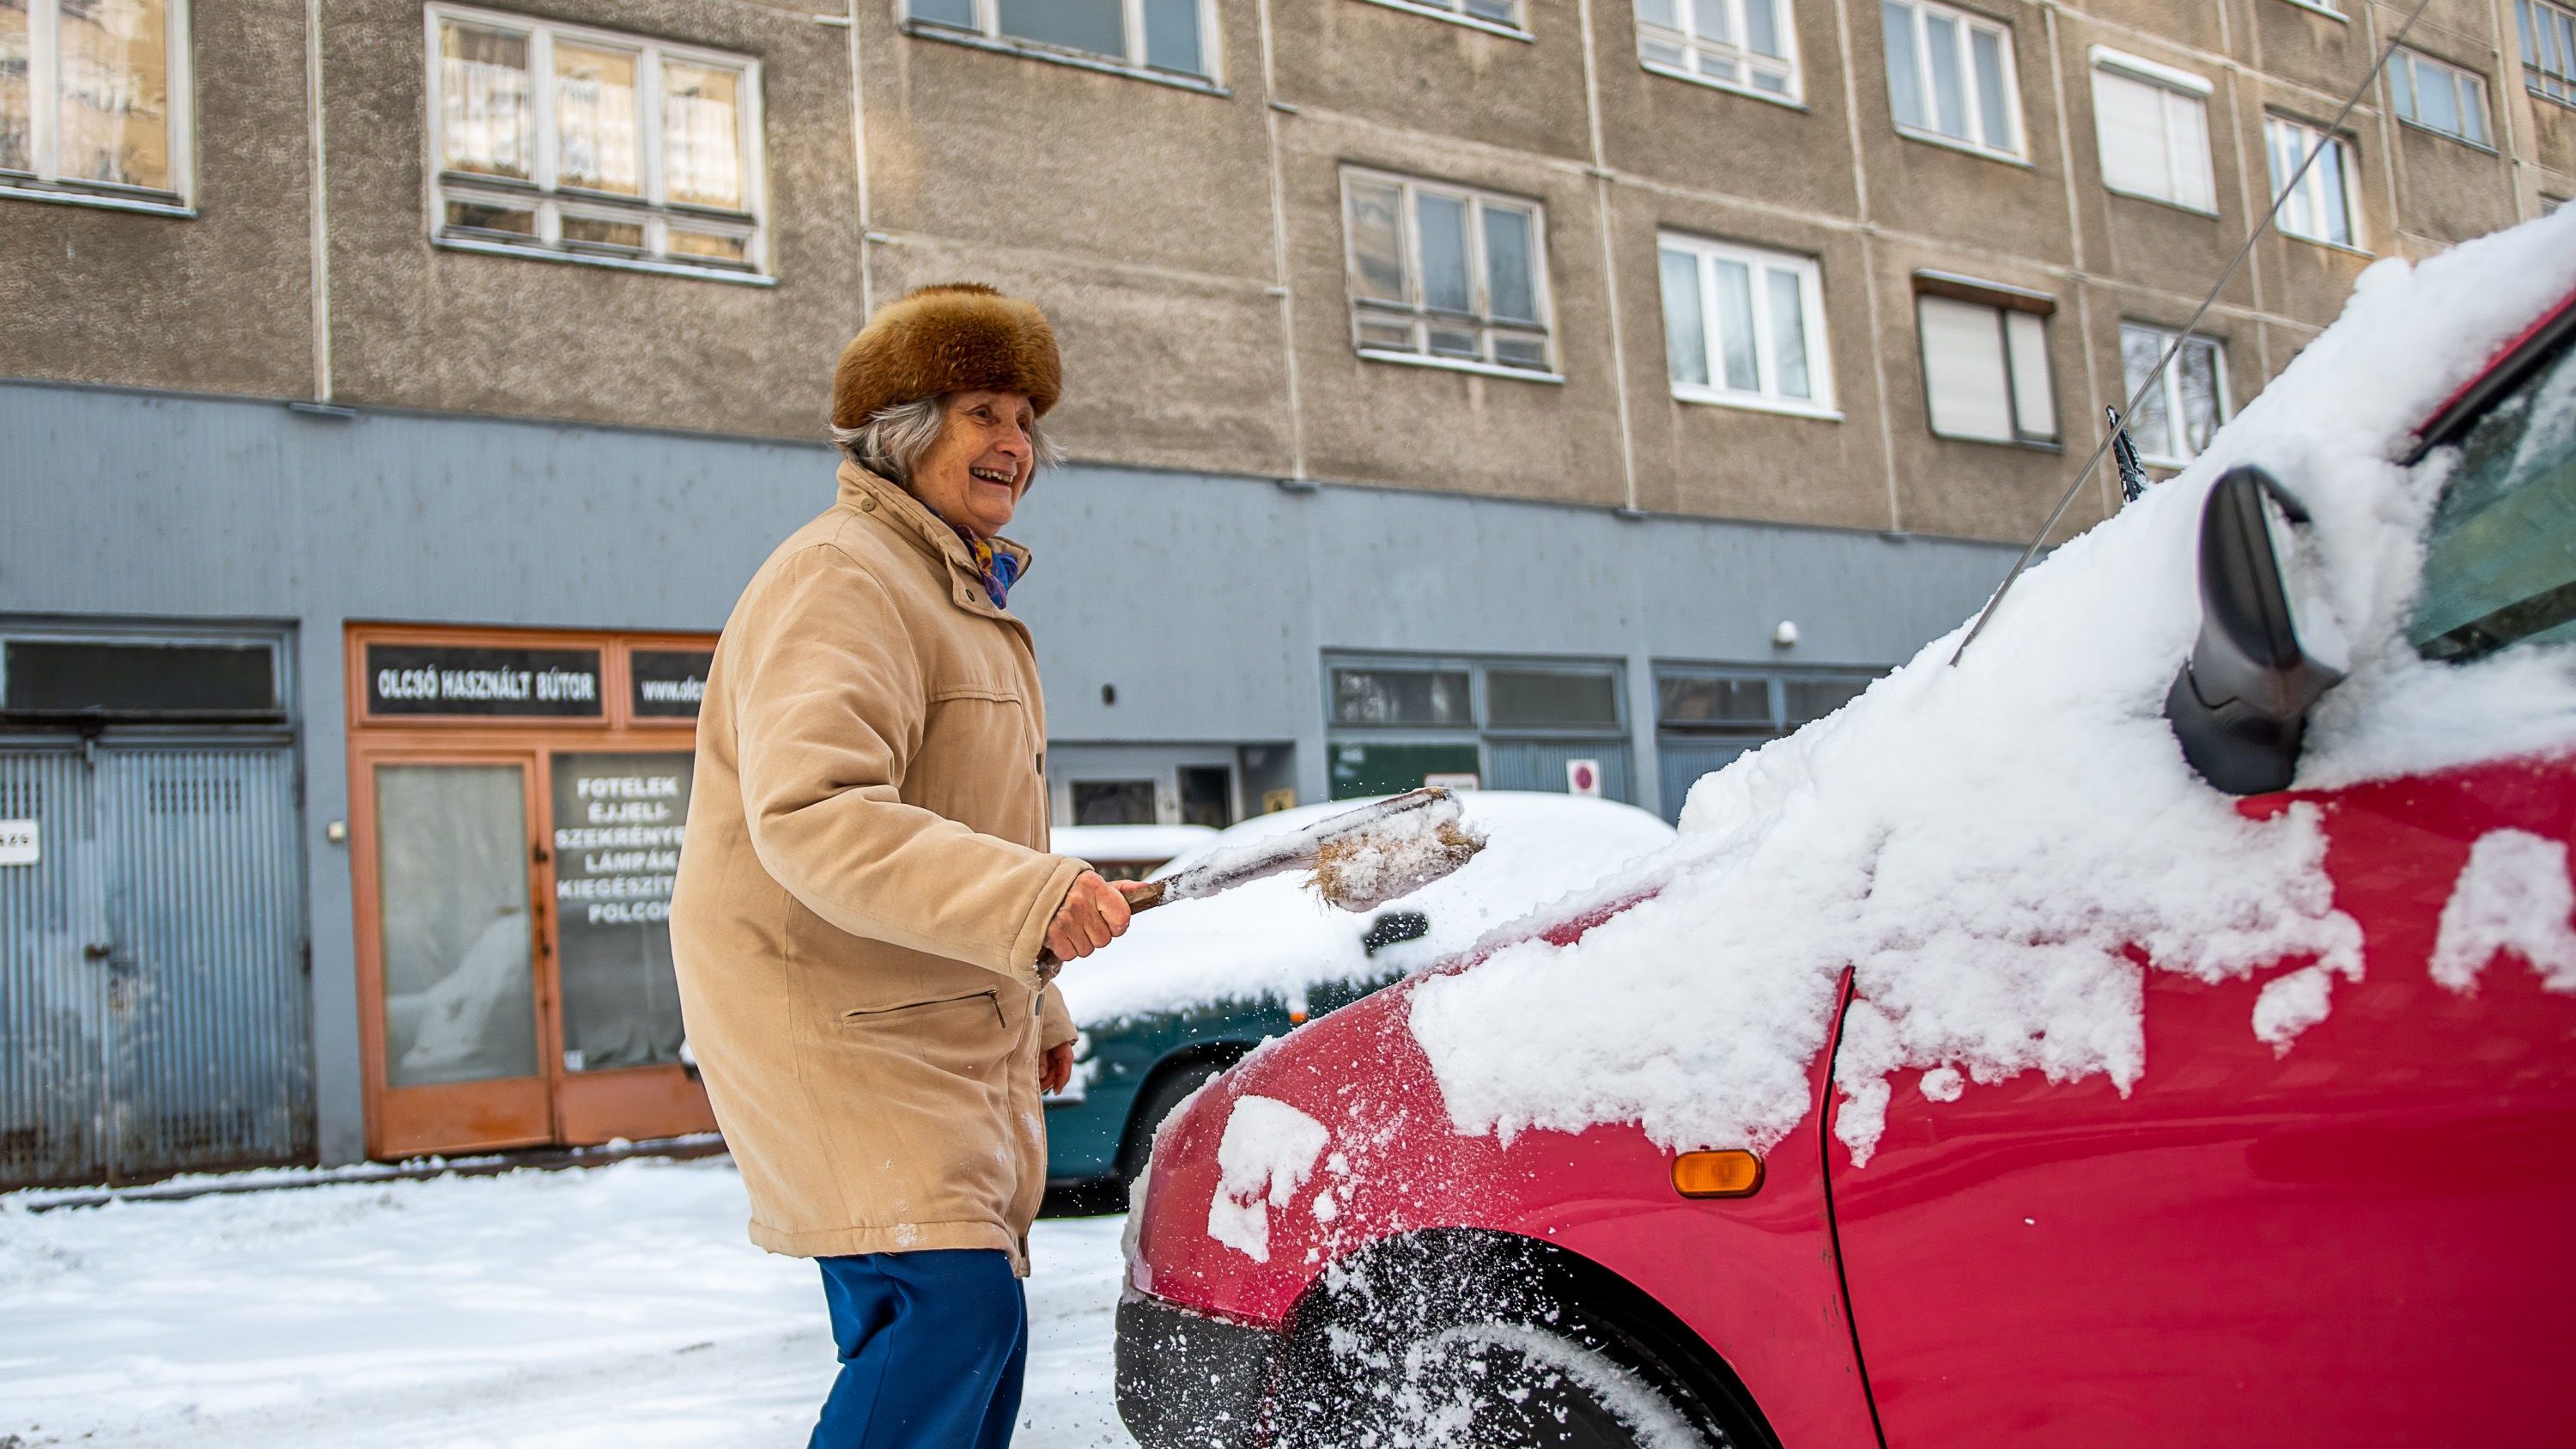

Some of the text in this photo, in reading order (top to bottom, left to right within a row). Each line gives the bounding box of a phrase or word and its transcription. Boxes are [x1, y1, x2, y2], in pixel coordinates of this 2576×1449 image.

[378, 662, 596, 701] OLCSÓ HASZNÁLT BÚTOR
[577, 776, 678, 798] FOTELEK
[587, 799, 671, 824] ÉJJELI-
[585, 848, 677, 874] LÁMPÁK
